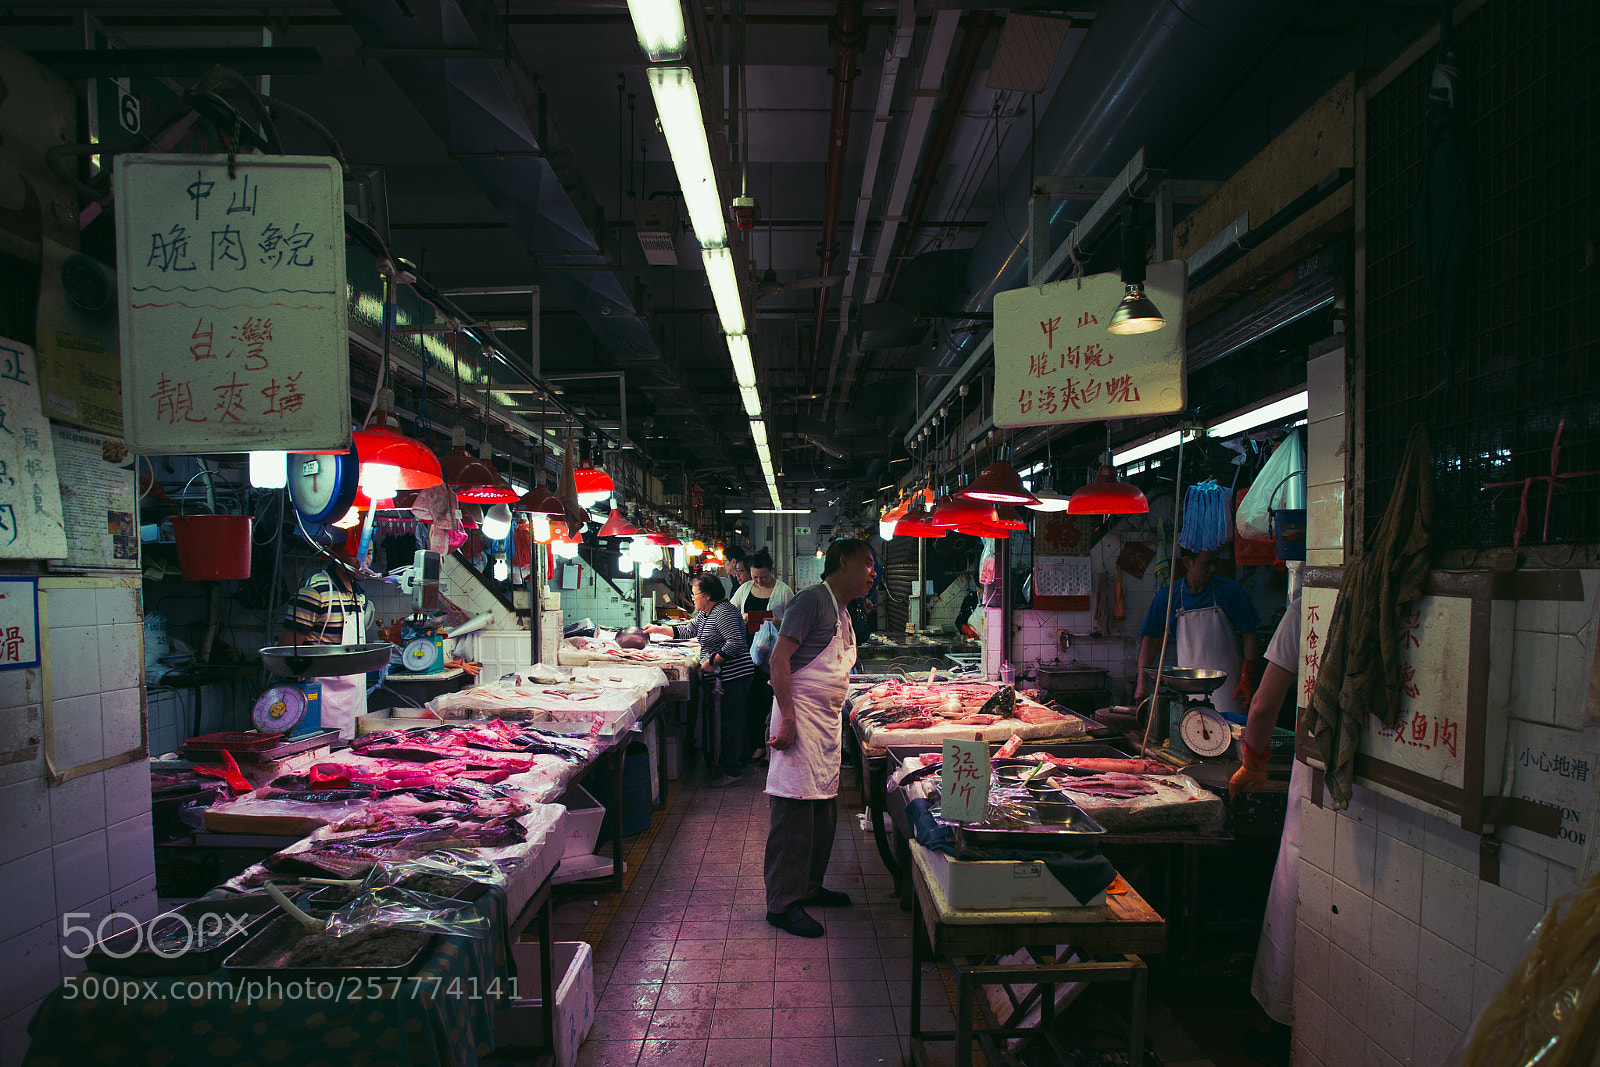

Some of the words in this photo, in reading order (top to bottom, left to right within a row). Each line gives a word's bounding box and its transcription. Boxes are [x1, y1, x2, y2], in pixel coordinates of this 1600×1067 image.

[186, 170, 258, 220] 中山
[1039, 311, 1098, 350] 中山
[1519, 747, 1590, 782] 小心地滑
